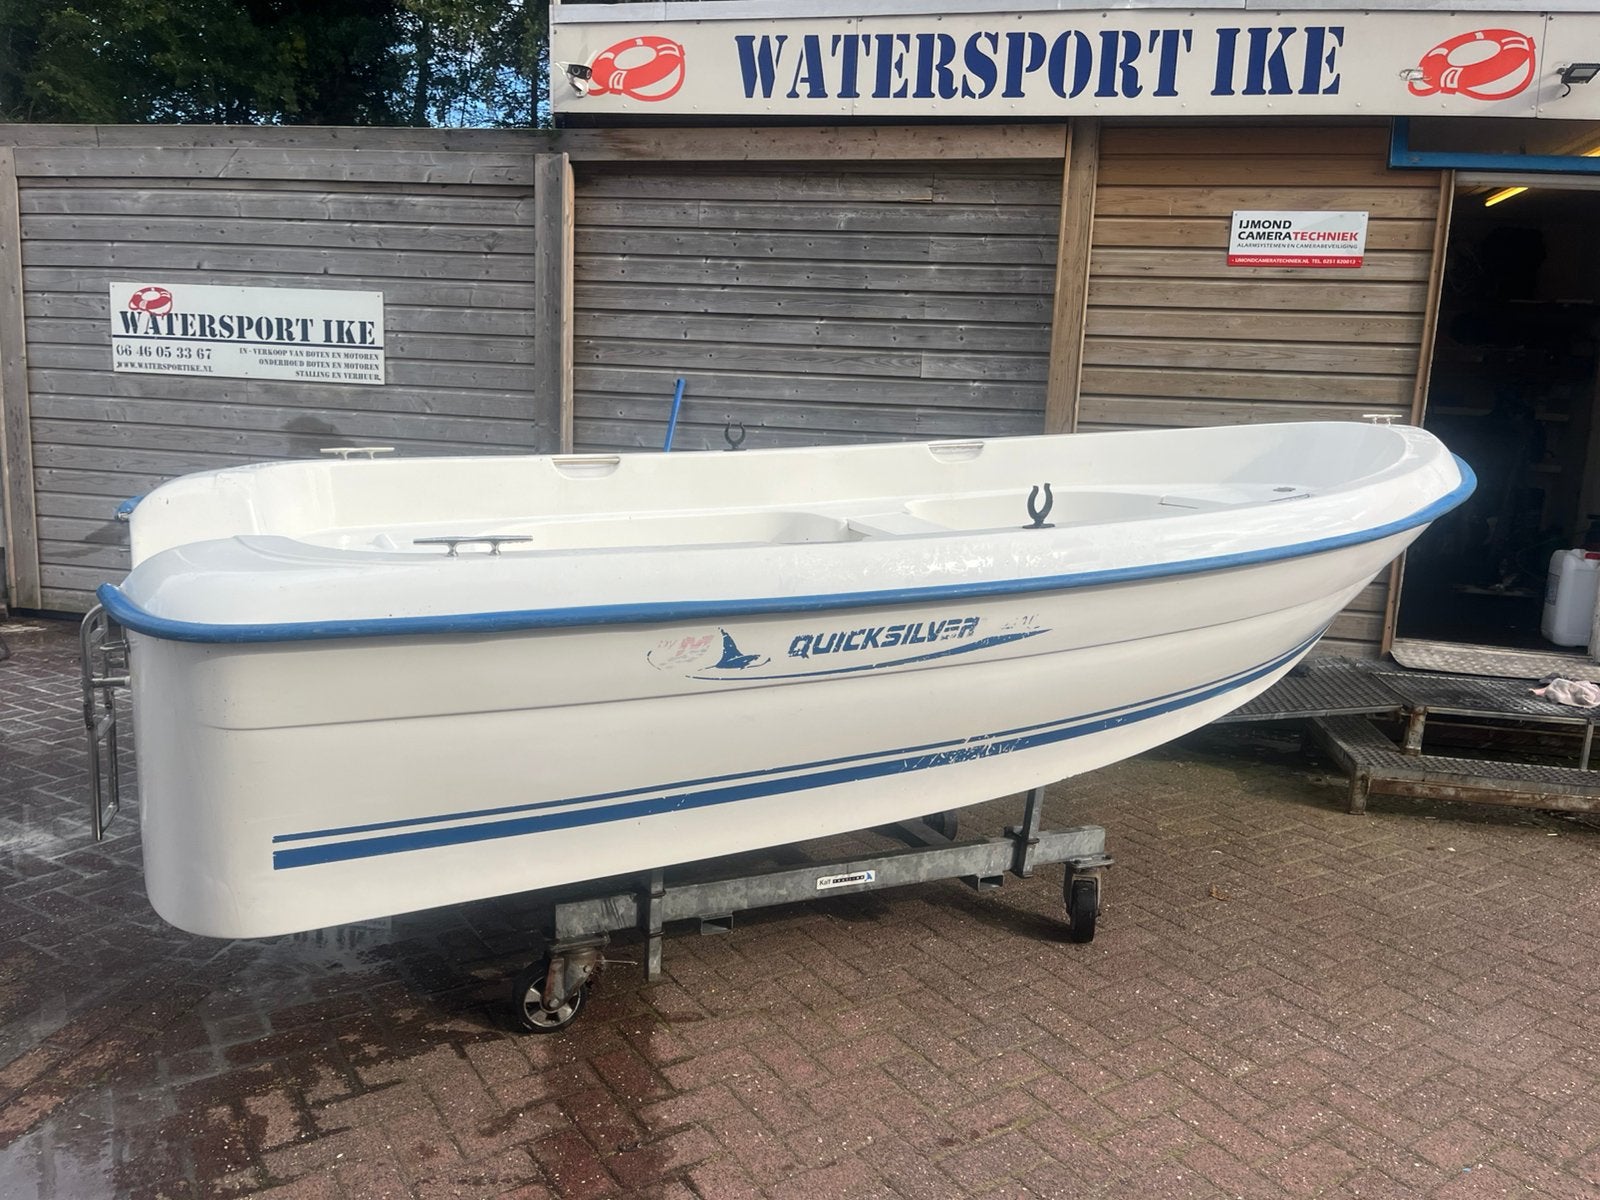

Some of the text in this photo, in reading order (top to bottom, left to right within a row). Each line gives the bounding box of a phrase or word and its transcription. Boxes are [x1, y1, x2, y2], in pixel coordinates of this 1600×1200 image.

[735, 26, 1345, 100] WATERSPORT IKE
[1239, 219, 1292, 229] IJMOND
[1238, 231, 1359, 241] CAMERATECHNIEK
[119, 311, 375, 345] WATERSPORT IKE
[116, 344, 212, 360] 06 46 05 33 67
[253, 348, 288, 356] VERKOOP
[288, 349, 304, 357] VAN
[306, 350, 330, 359] BOTEN
[343, 352, 380, 360] MOTOREN
[116, 361, 214, 372] WWW.WATERSPORTIKE.NL
[258, 358, 305, 367] ONDERHOUD
[306, 360, 330, 368] BOTEN
[344, 362, 380, 370] MOTOREN
[296, 370, 330, 378] STALLING
[788, 616, 980, 659] QUICKSILVER
